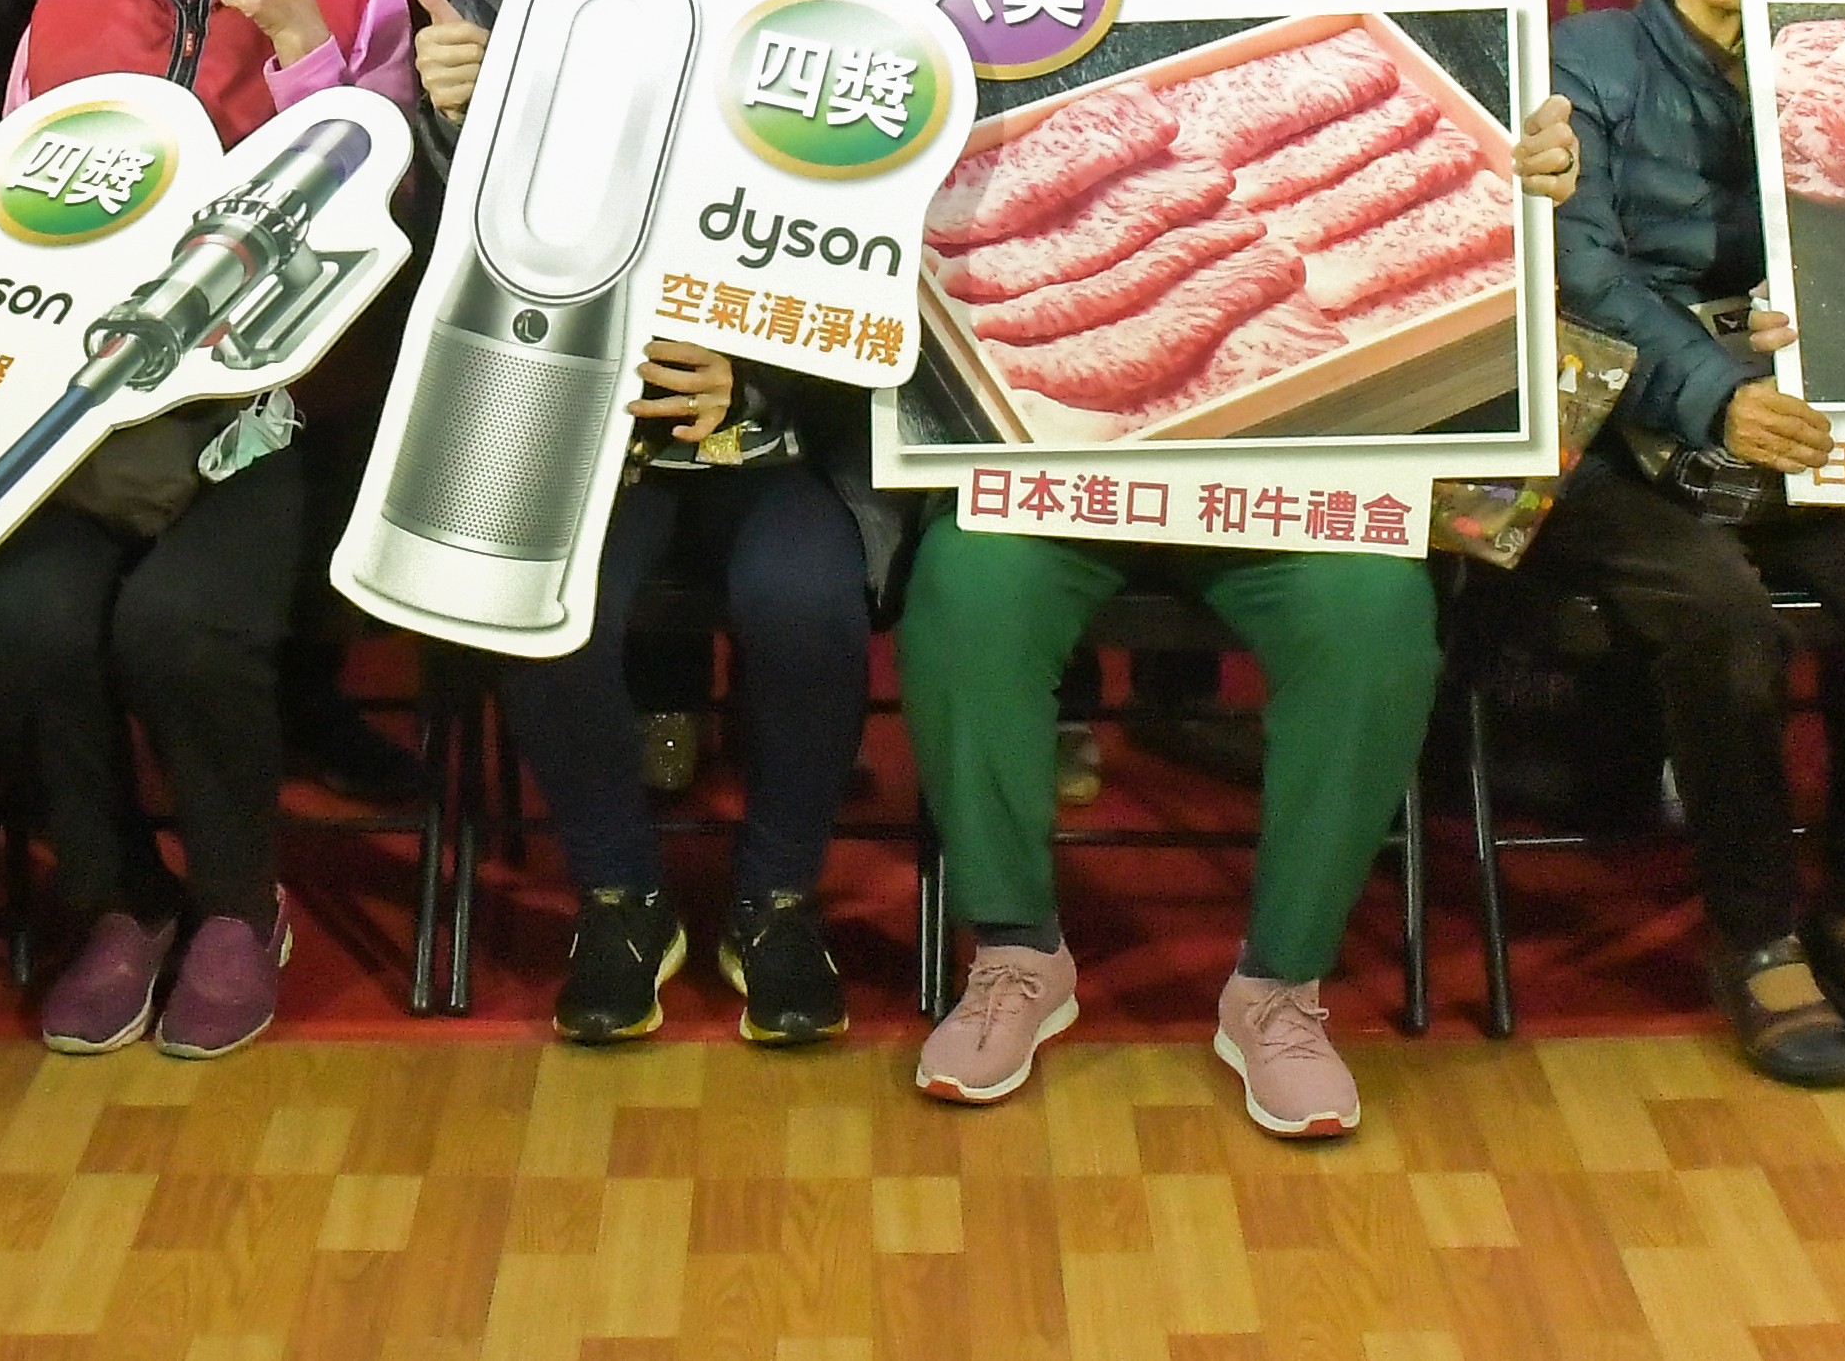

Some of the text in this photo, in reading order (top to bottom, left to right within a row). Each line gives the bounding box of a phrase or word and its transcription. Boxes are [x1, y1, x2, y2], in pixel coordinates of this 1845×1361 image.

[742, 27, 918, 141] 四獎
[5, 131, 156, 215] 四獎
[697, 186, 902, 279] dyson
[653, 271, 905, 368] 空氣清淨機
[969, 467, 1414, 546] 日本進口 和牛禮盒
